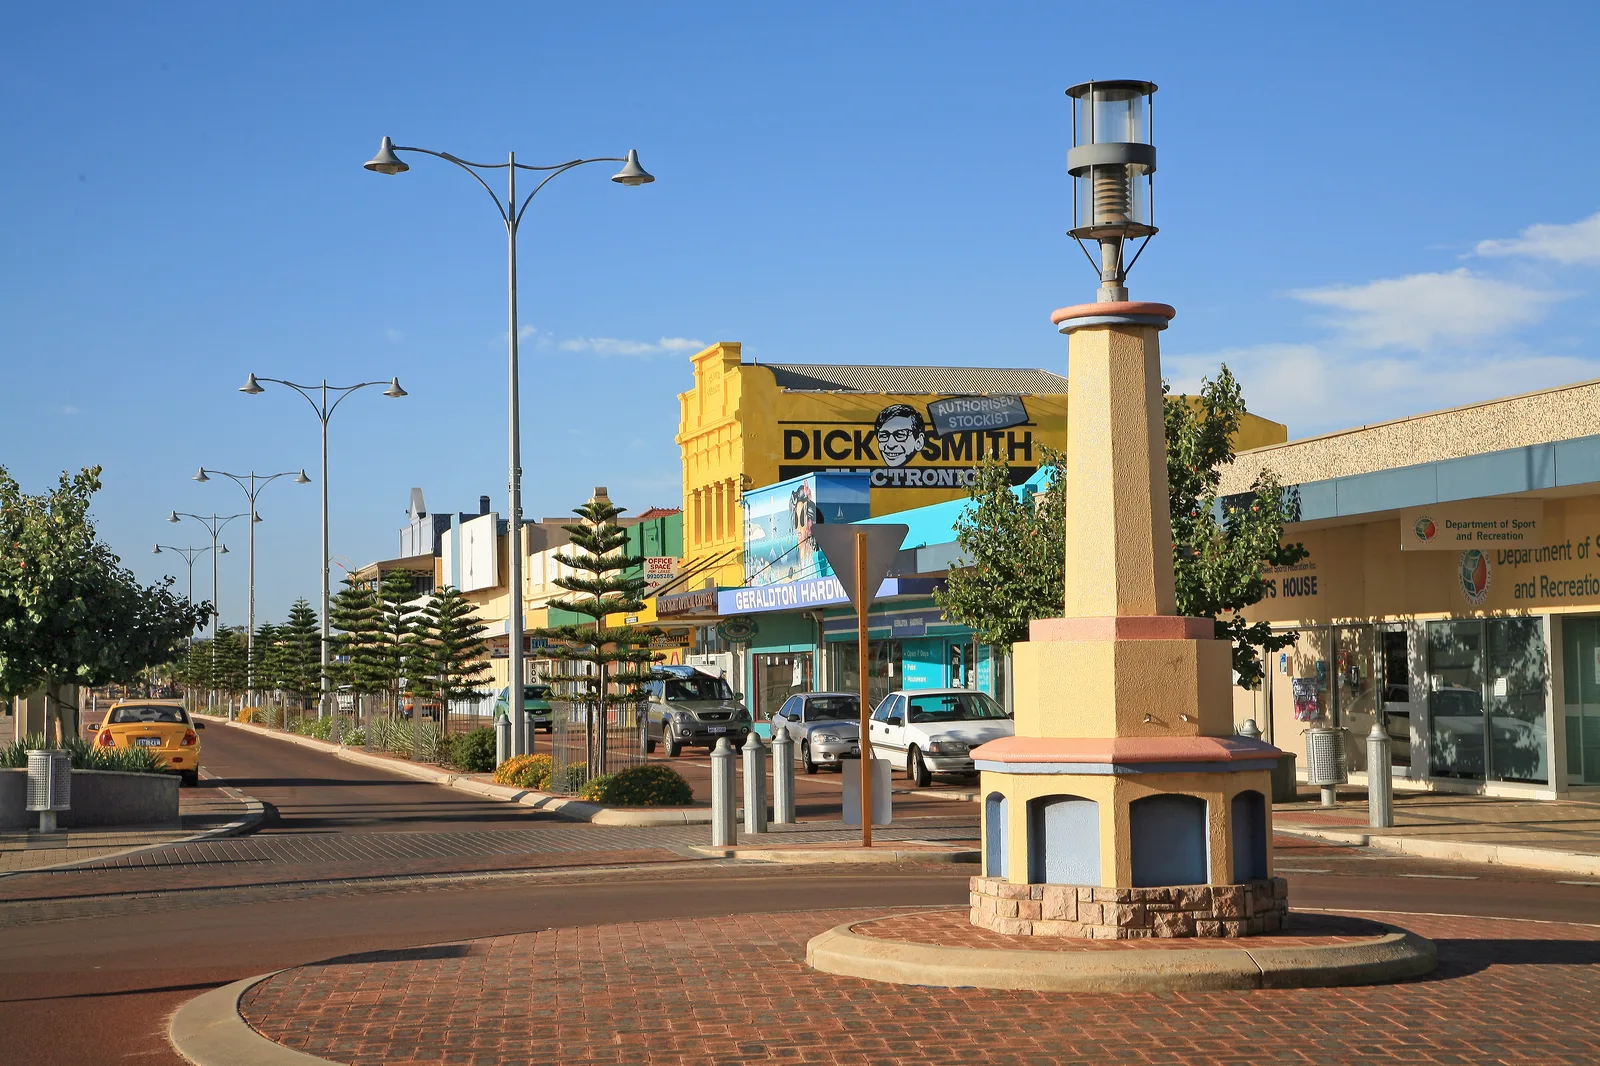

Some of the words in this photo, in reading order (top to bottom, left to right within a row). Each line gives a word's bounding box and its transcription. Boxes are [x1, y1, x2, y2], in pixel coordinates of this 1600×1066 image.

[938, 396, 1015, 417] AUTHORISED
[948, 411, 1010, 428] STOCKIST
[783, 429, 878, 461] DICK
[919, 429, 1032, 461] SMITH
[1445, 519, 1497, 530] Department
[1500, 519, 1508, 528] of
[1512, 519, 1536, 529] Sport
[1456, 531, 1472, 541] and
[1477, 531, 1524, 541] Recreation
[1497, 540, 1572, 568] Department
[1577, 536, 1590, 559] of
[735, 585, 798, 611] GERALDTON
[800, 579, 848, 603] HARDW
[1283, 576, 1317, 597] HOUSE
[1514, 576, 1536, 599] and
[1540, 573, 1600, 598] Recreatio
[695, 592, 713, 607] EXPRESS
[667, 635, 688, 643] SMITH
